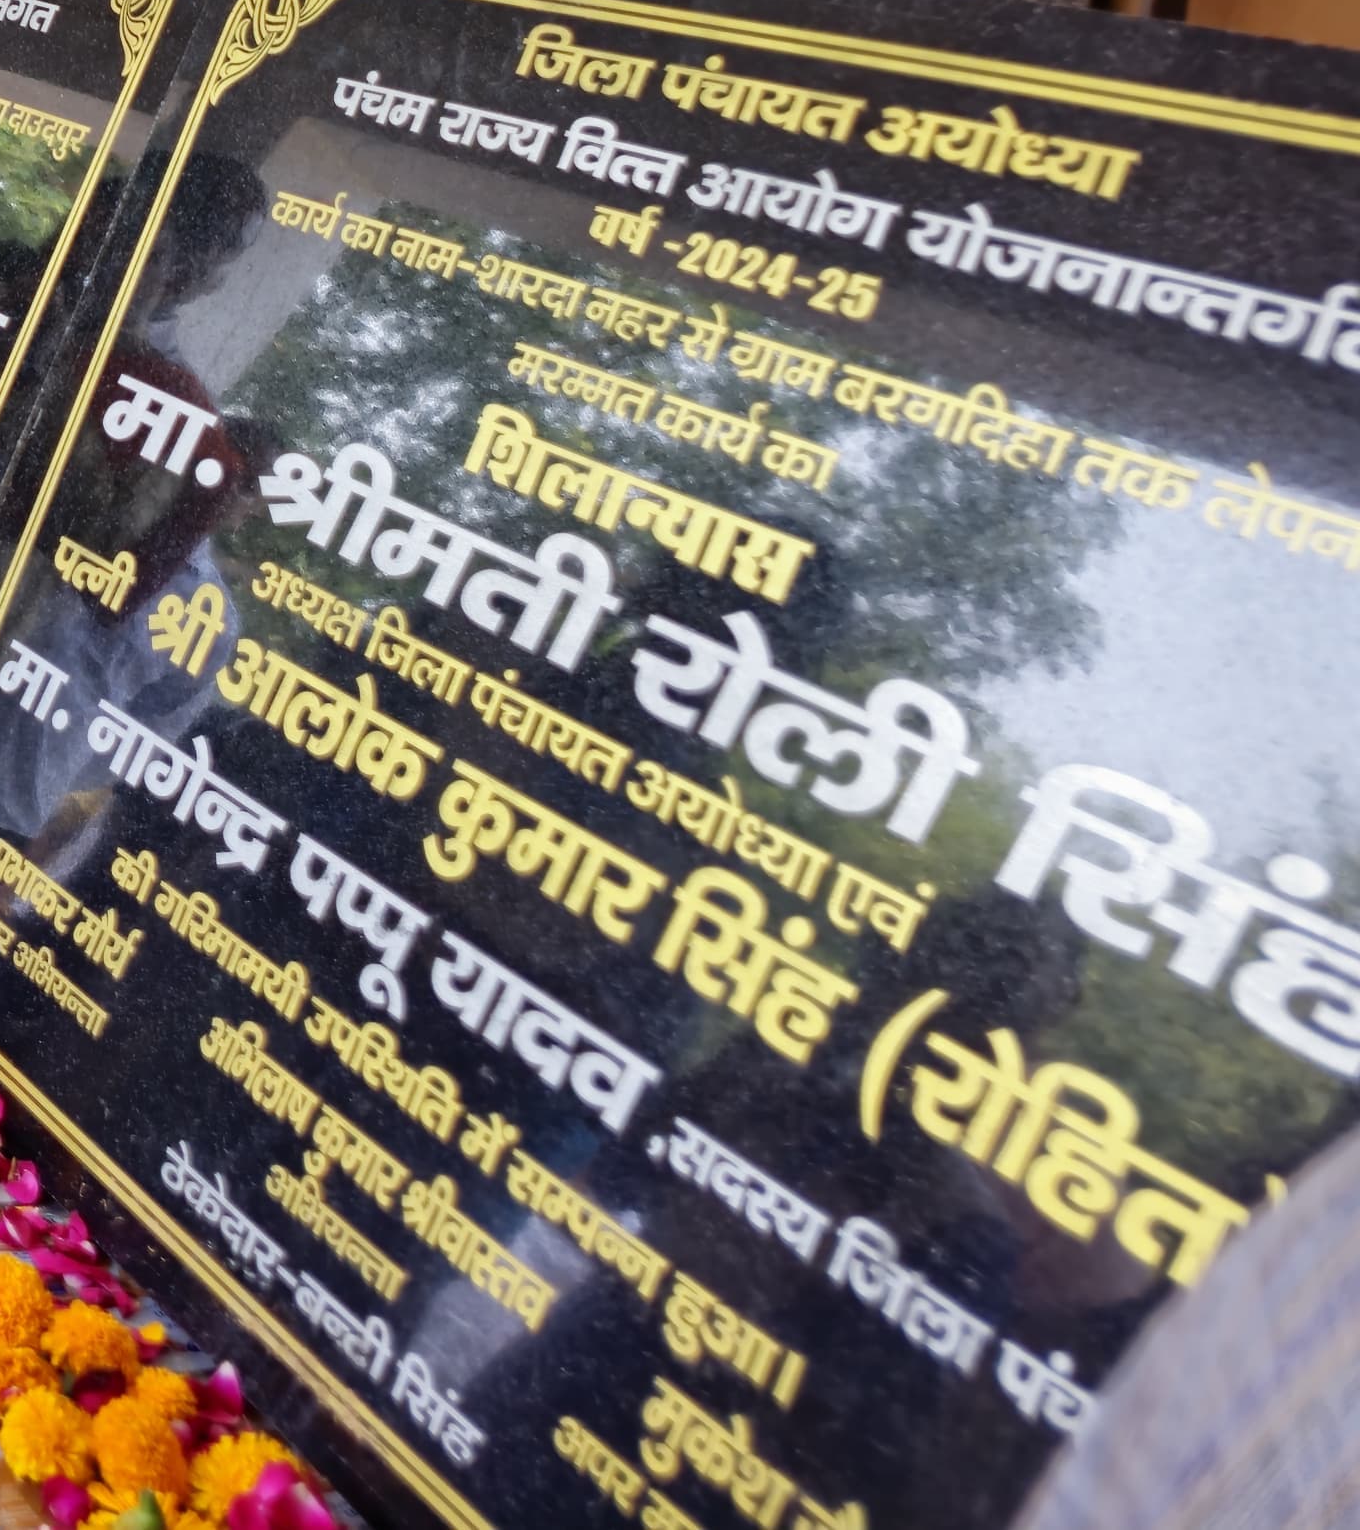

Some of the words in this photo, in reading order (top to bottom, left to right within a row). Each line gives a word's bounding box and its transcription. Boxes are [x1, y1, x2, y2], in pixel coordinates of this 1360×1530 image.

[8, 102, 91, 161] दाउदपुर
[333, 69, 437, 133] पंचम
[439, 101, 554, 164] राज्य
[686, 162, 902, 250] आयोग
[515, 22, 655, 100] जिला
[660, 55, 867, 143] पंचायत
[864, 105, 1141, 201] अयोध्या
[588, 203, 664, 256] वर्ष
[270, 190, 348, 241] कार्य
[341, 214, 394, 257] का
[585, 288, 680, 350] नहर
[682, 304, 729, 363] से
[729, 333, 836, 399] ग्राम
[1075, 437, 1199, 512] तक
[506, 342, 654, 426] मरम्मत
[656, 402, 773, 466] कार्य
[763, 431, 839, 494] का
[463, 403, 817, 606] शिलान्यास
[102, 373, 224, 490] मा.
[258, 442, 625, 675] श्रीमती
[630, 610, 982, 847] रोली
[251, 561, 369, 651] अध्यक्ष
[363, 606, 474, 707] जिला
[469, 670, 632, 793] पंचायत
[626, 776, 833, 901] अयोध्या
[826, 860, 936, 955] एवं
[13, 938, 110, 1039] अभियन्ता
[54, 535, 138, 614] पत्नी
[148, 582, 227, 678] श्री
[216, 638, 444, 801] आलोक
[422, 758, 664, 948] कुमार
[653, 866, 860, 1067] सिंह
[859, 987, 1288, 1291] (रोहित
[76, 903, 144, 981] मौर्य
[87, 699, 287, 874] नागेन्द्र
[290, 833, 432, 1021] पप्पू
[431, 930, 663, 1138] यादव
[826, 1215, 995, 1374] जिला
[109, 846, 158, 905] की
[154, 882, 307, 1021] गरिमामयी
[304, 994, 463, 1144] उपस्थिति
[460, 1113, 521, 1176] में
[504, 1147, 672, 1300] सम्पन्न
[199, 1015, 323, 1137] अभिलाष
[303, 1102, 411, 1212] कुमार
[401, 1176, 557, 1333] श्रीवास्तव
[264, 1163, 411, 1301] अभियन्ता
[391, 1352, 485, 1466] सिंह
[552, 1416, 649, 1516] अपर
[639, 1376, 796, 1530] मुकेश
